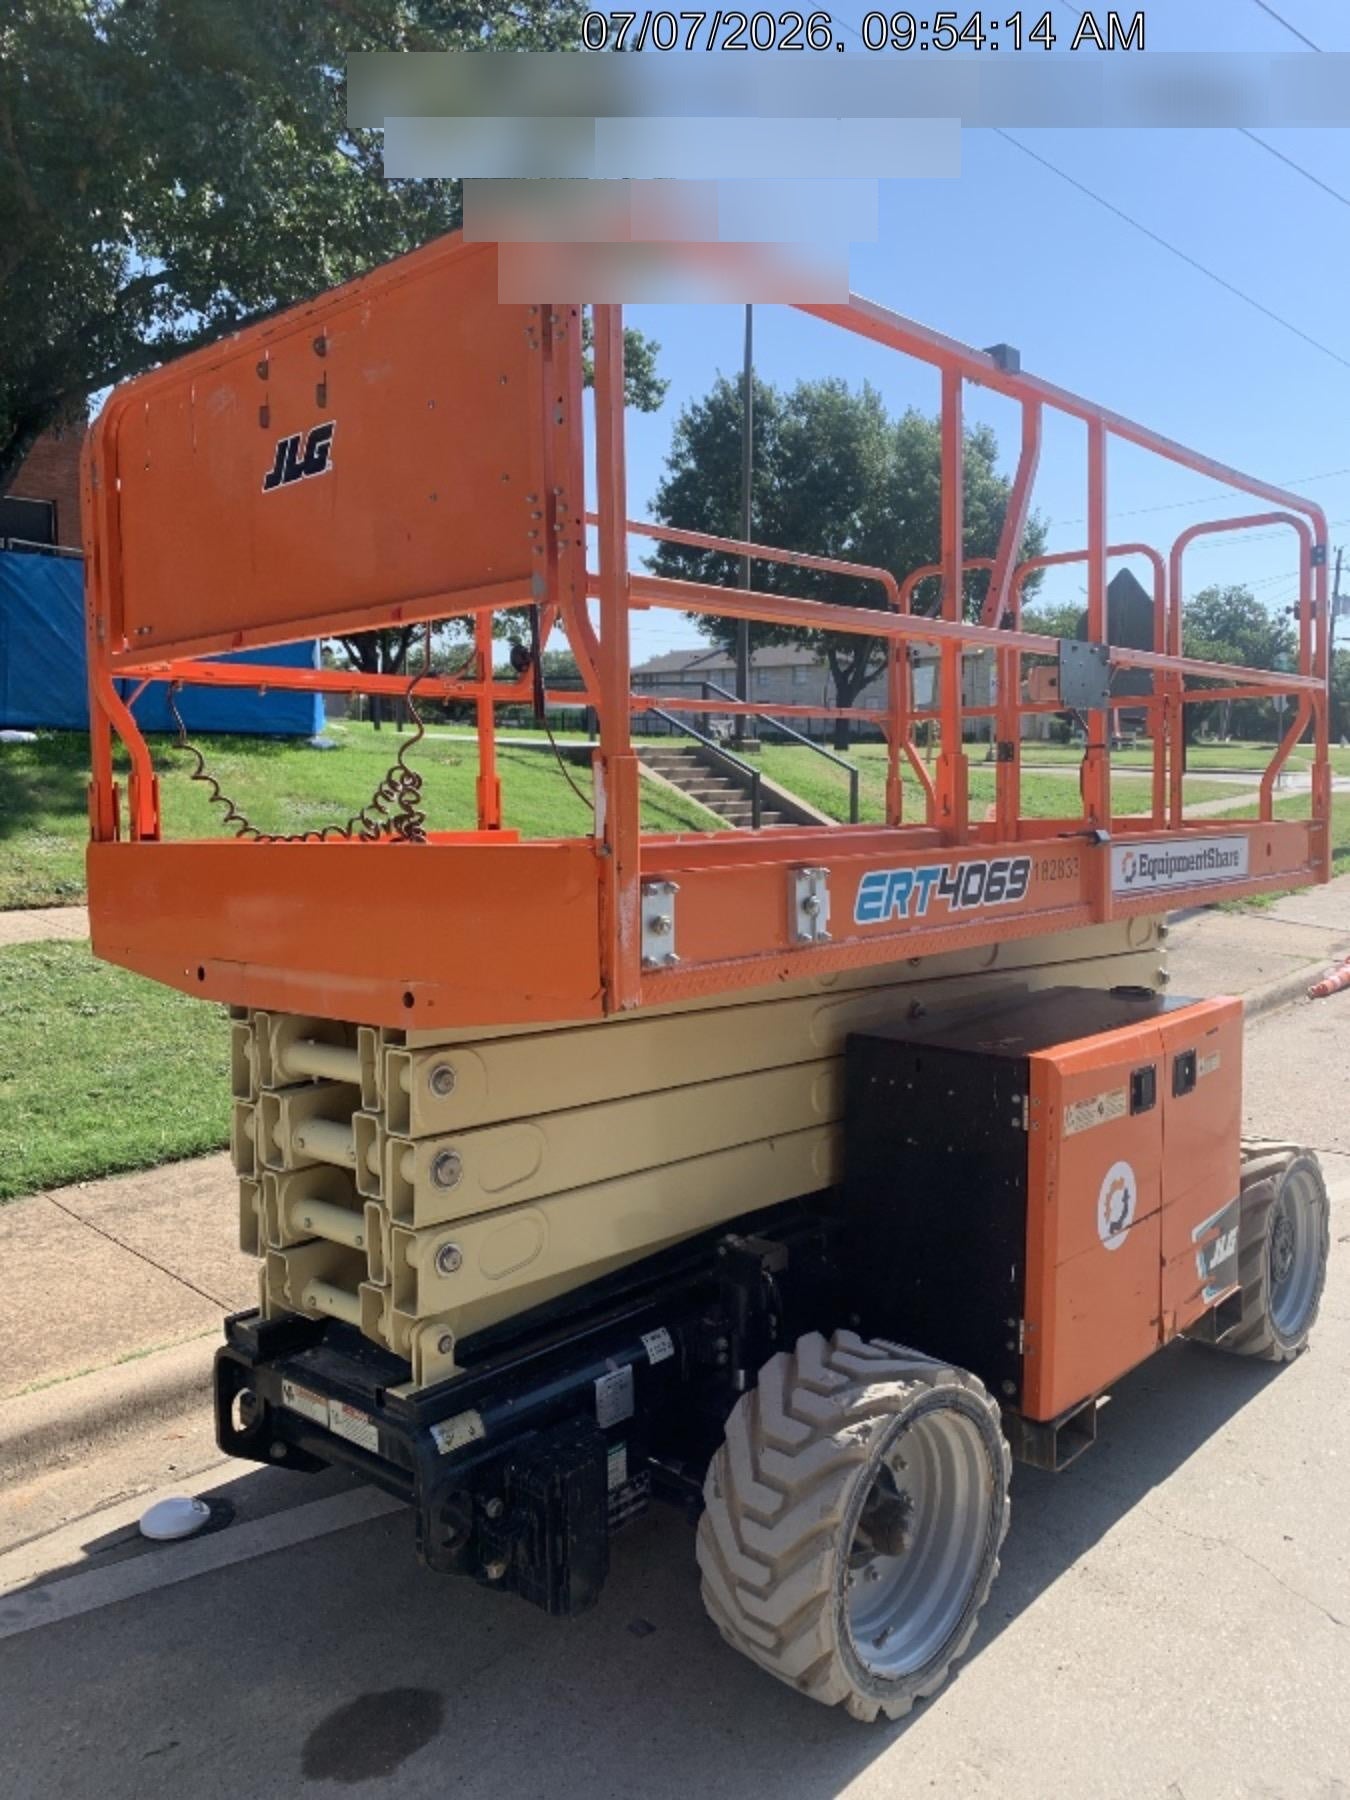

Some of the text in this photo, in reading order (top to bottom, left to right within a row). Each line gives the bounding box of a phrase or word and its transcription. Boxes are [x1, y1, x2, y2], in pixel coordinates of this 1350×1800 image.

[262, 420, 336, 493] JLG
[854, 856, 1031, 925] ERT4069
[1139, 847, 1239, 880] EquipmentShare
